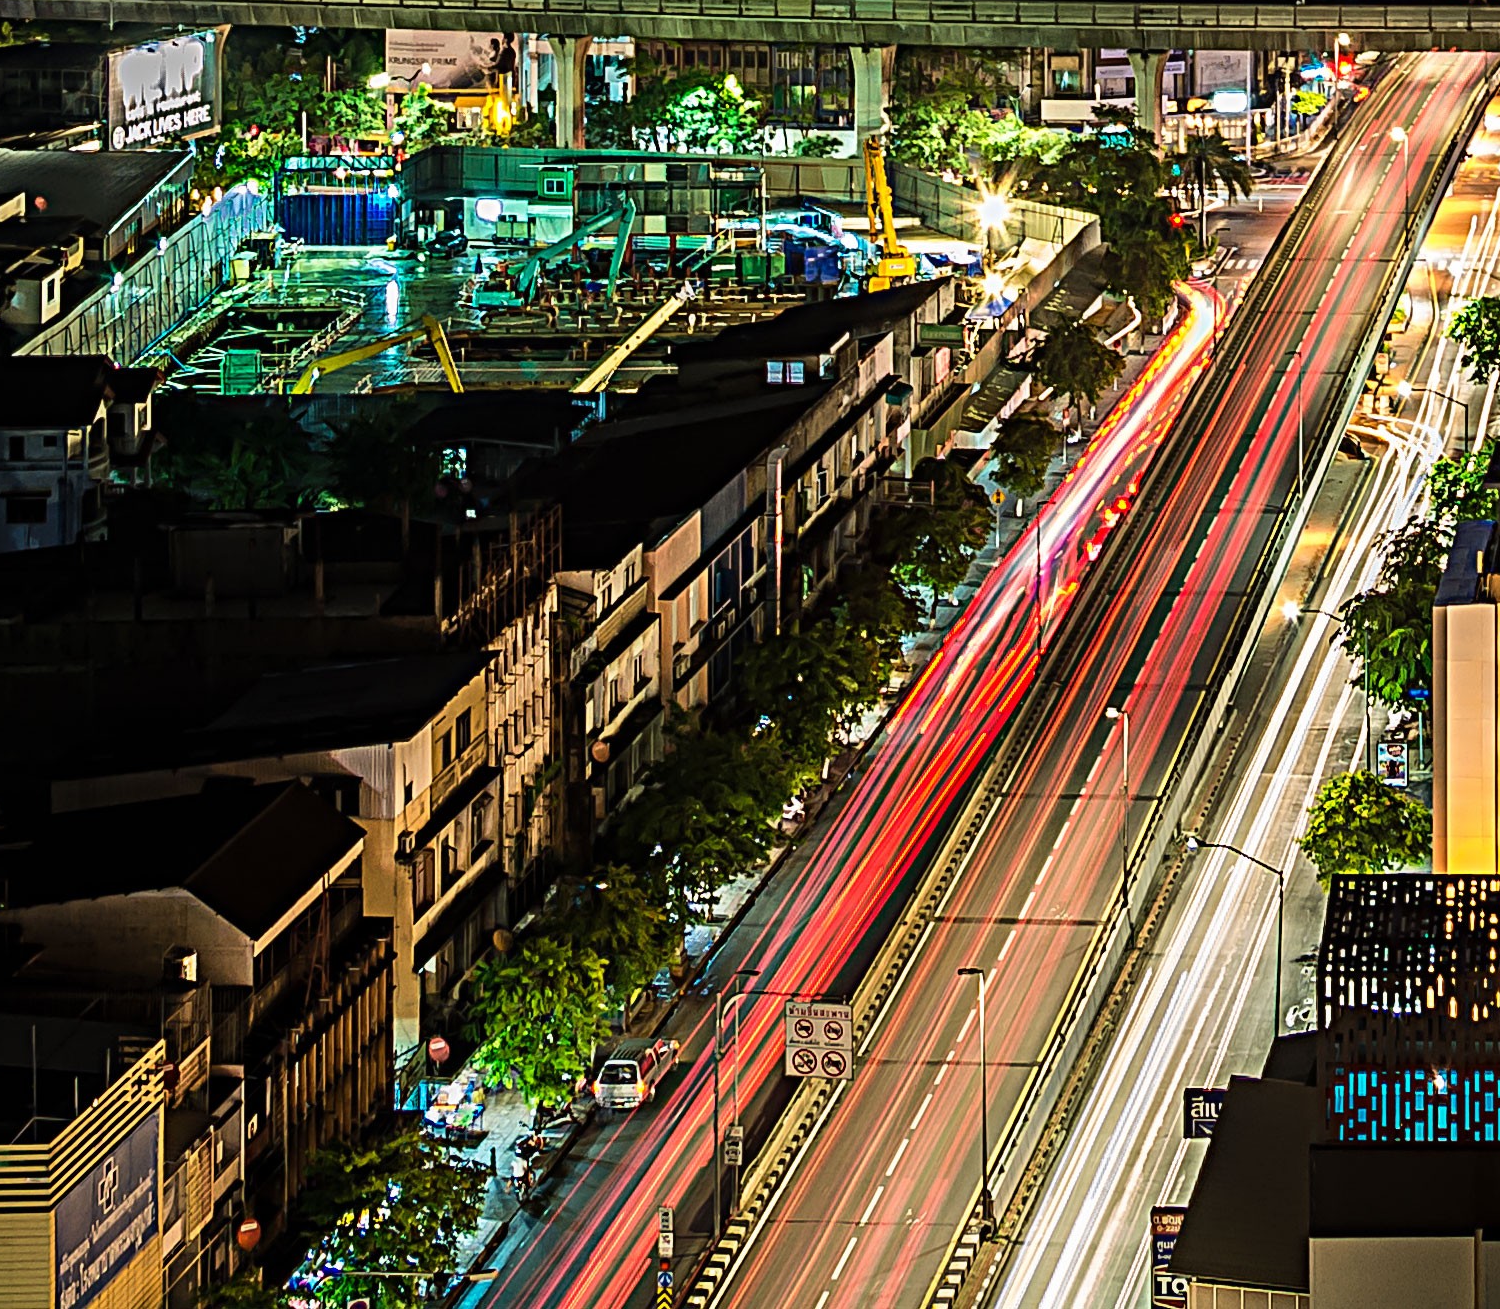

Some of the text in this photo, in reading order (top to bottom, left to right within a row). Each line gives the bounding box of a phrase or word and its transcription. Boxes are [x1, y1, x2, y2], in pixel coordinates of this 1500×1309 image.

[125, 120, 152, 144] JACK
[153, 113, 182, 137] LIVES
[183, 104, 212, 128] HERE
